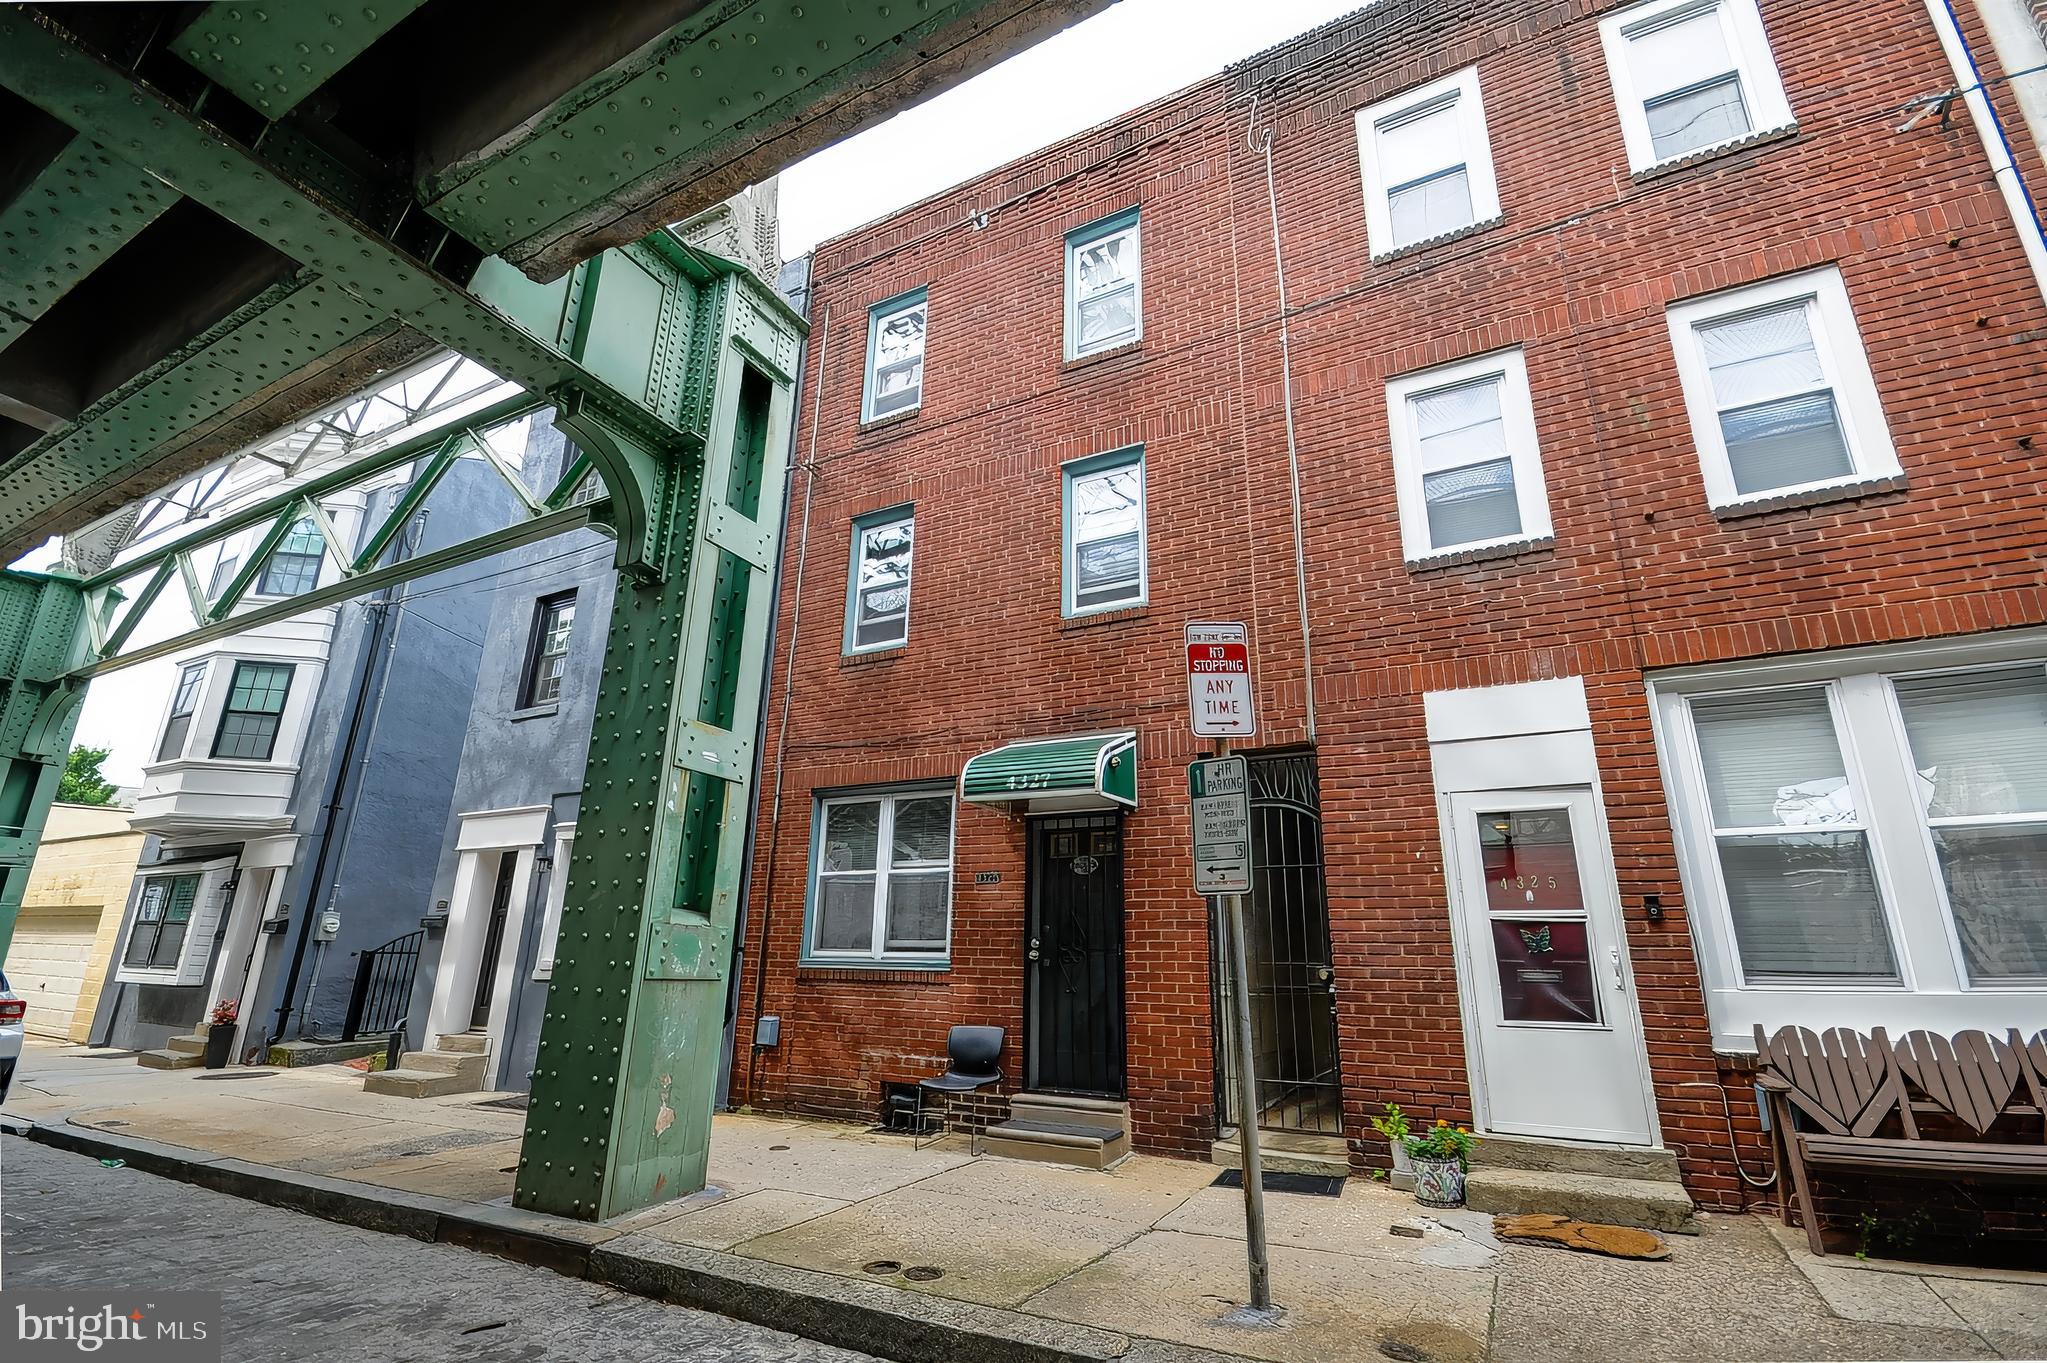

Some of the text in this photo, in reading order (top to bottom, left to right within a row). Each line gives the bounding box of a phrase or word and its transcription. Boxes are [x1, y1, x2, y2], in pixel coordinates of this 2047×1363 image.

[1209, 646, 1225, 659] NO
[1193, 659, 1244, 672] STOPPING
[1206, 679, 1233, 694] ANY
[1204, 700, 1240, 714] TIME
[1217, 762, 1232, 776] HR
[1207, 777, 1243, 793] PARKING
